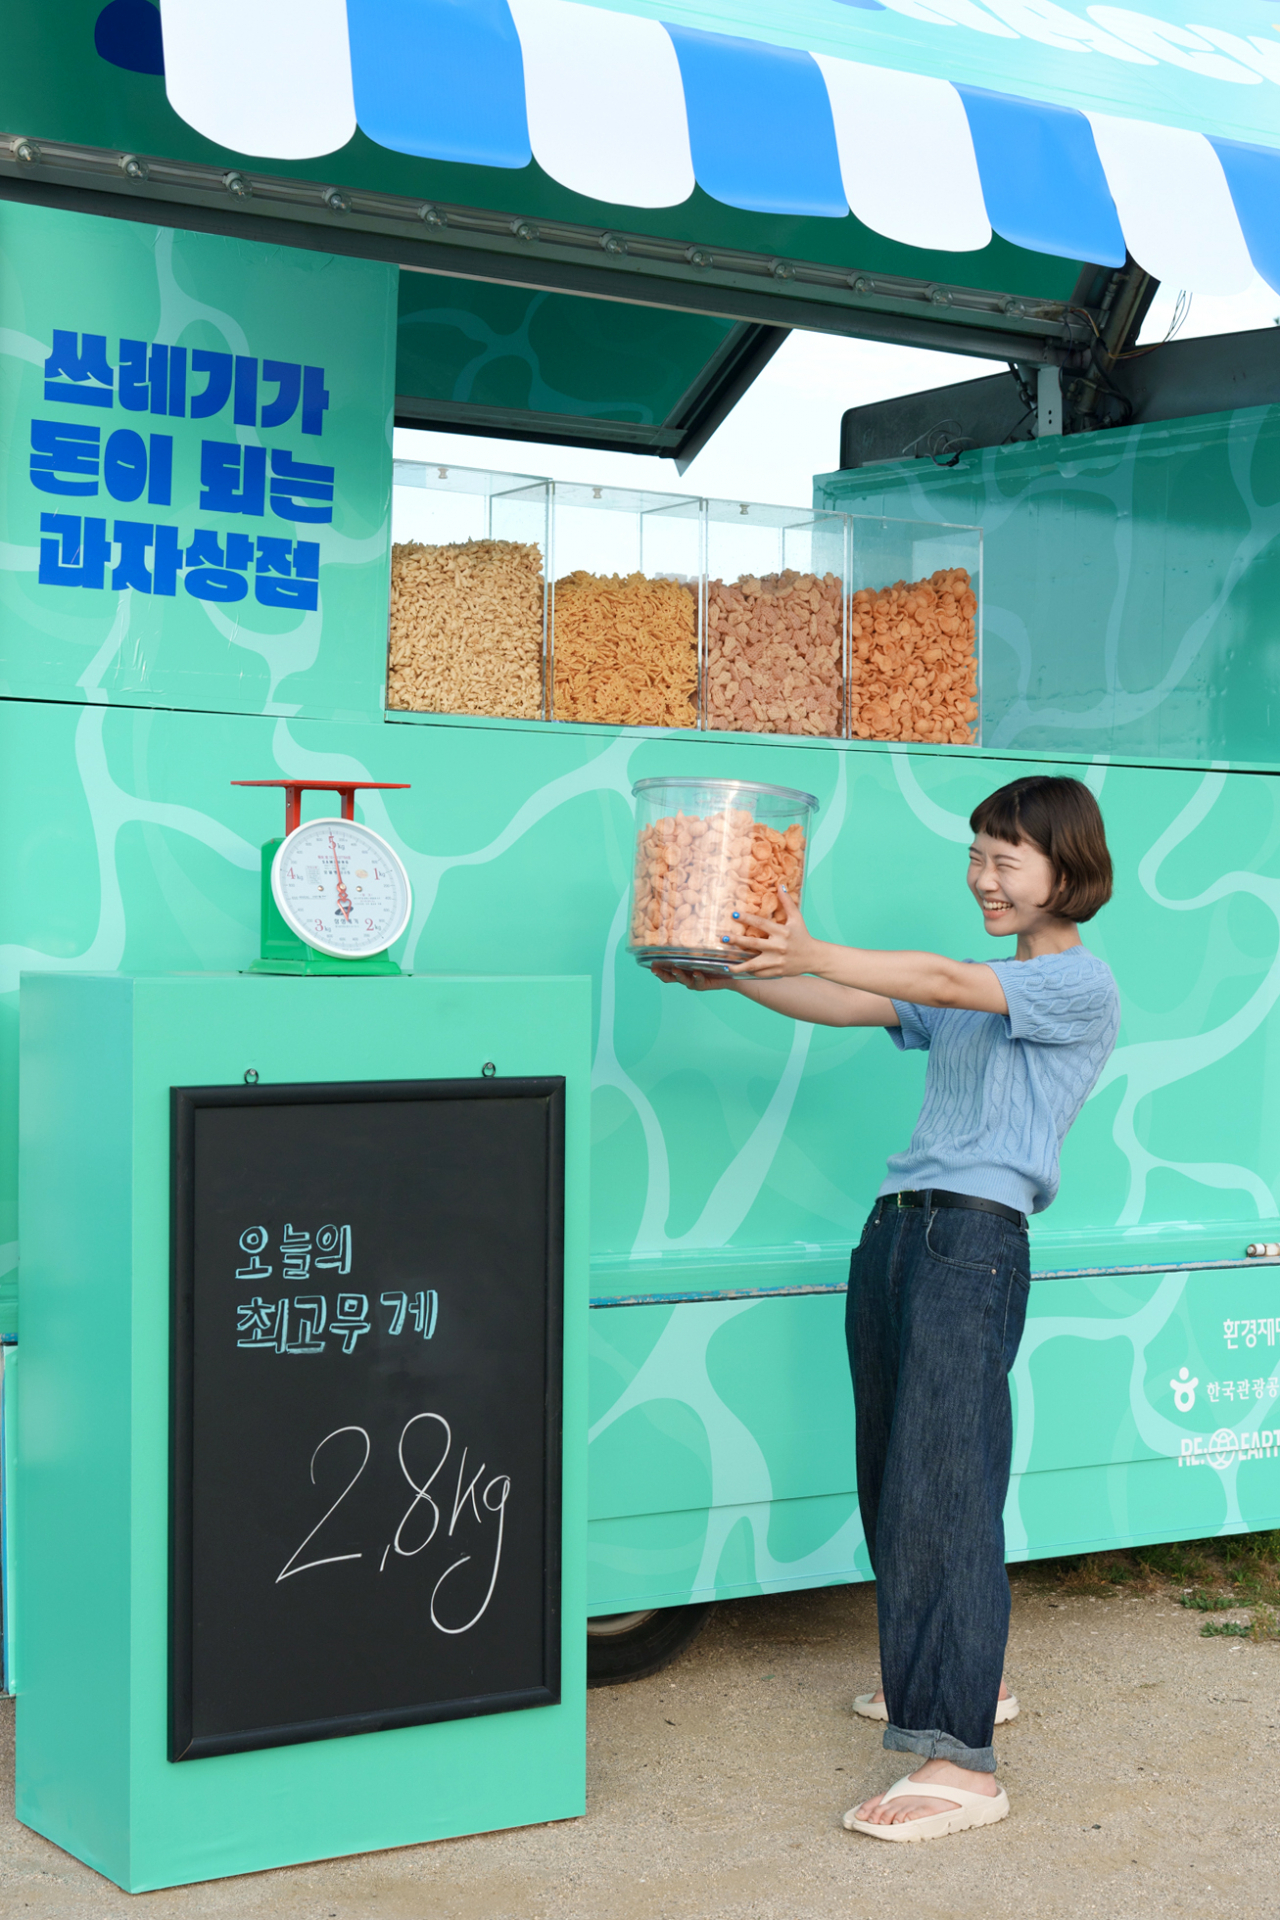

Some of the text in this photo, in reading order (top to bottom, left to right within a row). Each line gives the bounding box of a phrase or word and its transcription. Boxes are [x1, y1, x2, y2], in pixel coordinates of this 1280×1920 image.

[44, 328, 330, 436] 쓰레기가
[30, 419, 335, 524] 돈이 되는
[38, 511, 320, 612] 과자상점
[235, 1223, 352, 1280] 오늘의
[1206, 1376, 1280, 1403] 한국관광공
